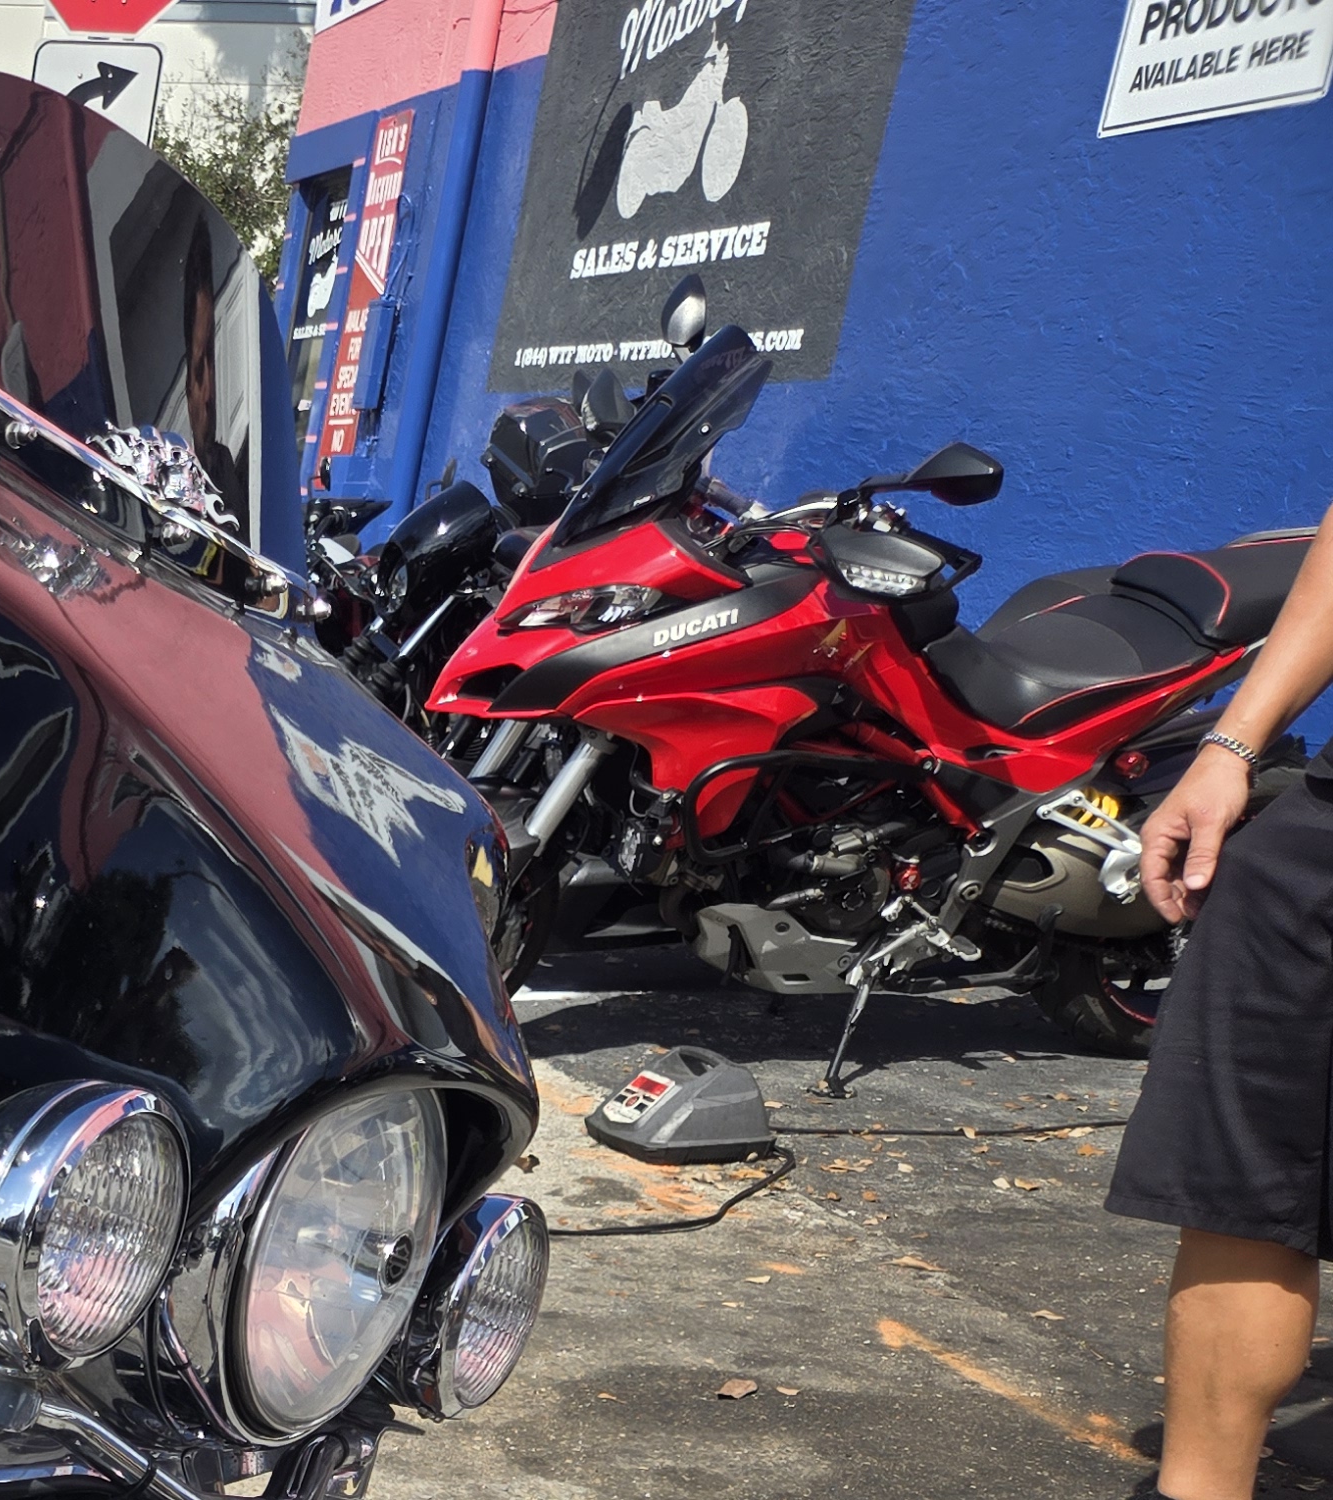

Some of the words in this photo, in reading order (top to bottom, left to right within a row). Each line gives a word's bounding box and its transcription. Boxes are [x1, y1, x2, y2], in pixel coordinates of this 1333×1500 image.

[1128, 43, 1244, 94] AVAILABLE
[1247, 29, 1315, 69] HERE
[358, 213, 395, 281] OPEN
[570, 241, 639, 279] SALES
[637, 239, 657, 270] &
[658, 221, 771, 268] SERVICE
[548, 346, 576, 365] WTF
[574, 344, 613, 365] MOTO
[331, 428, 345, 453] NO
[652, 607, 739, 647] DUCATI
